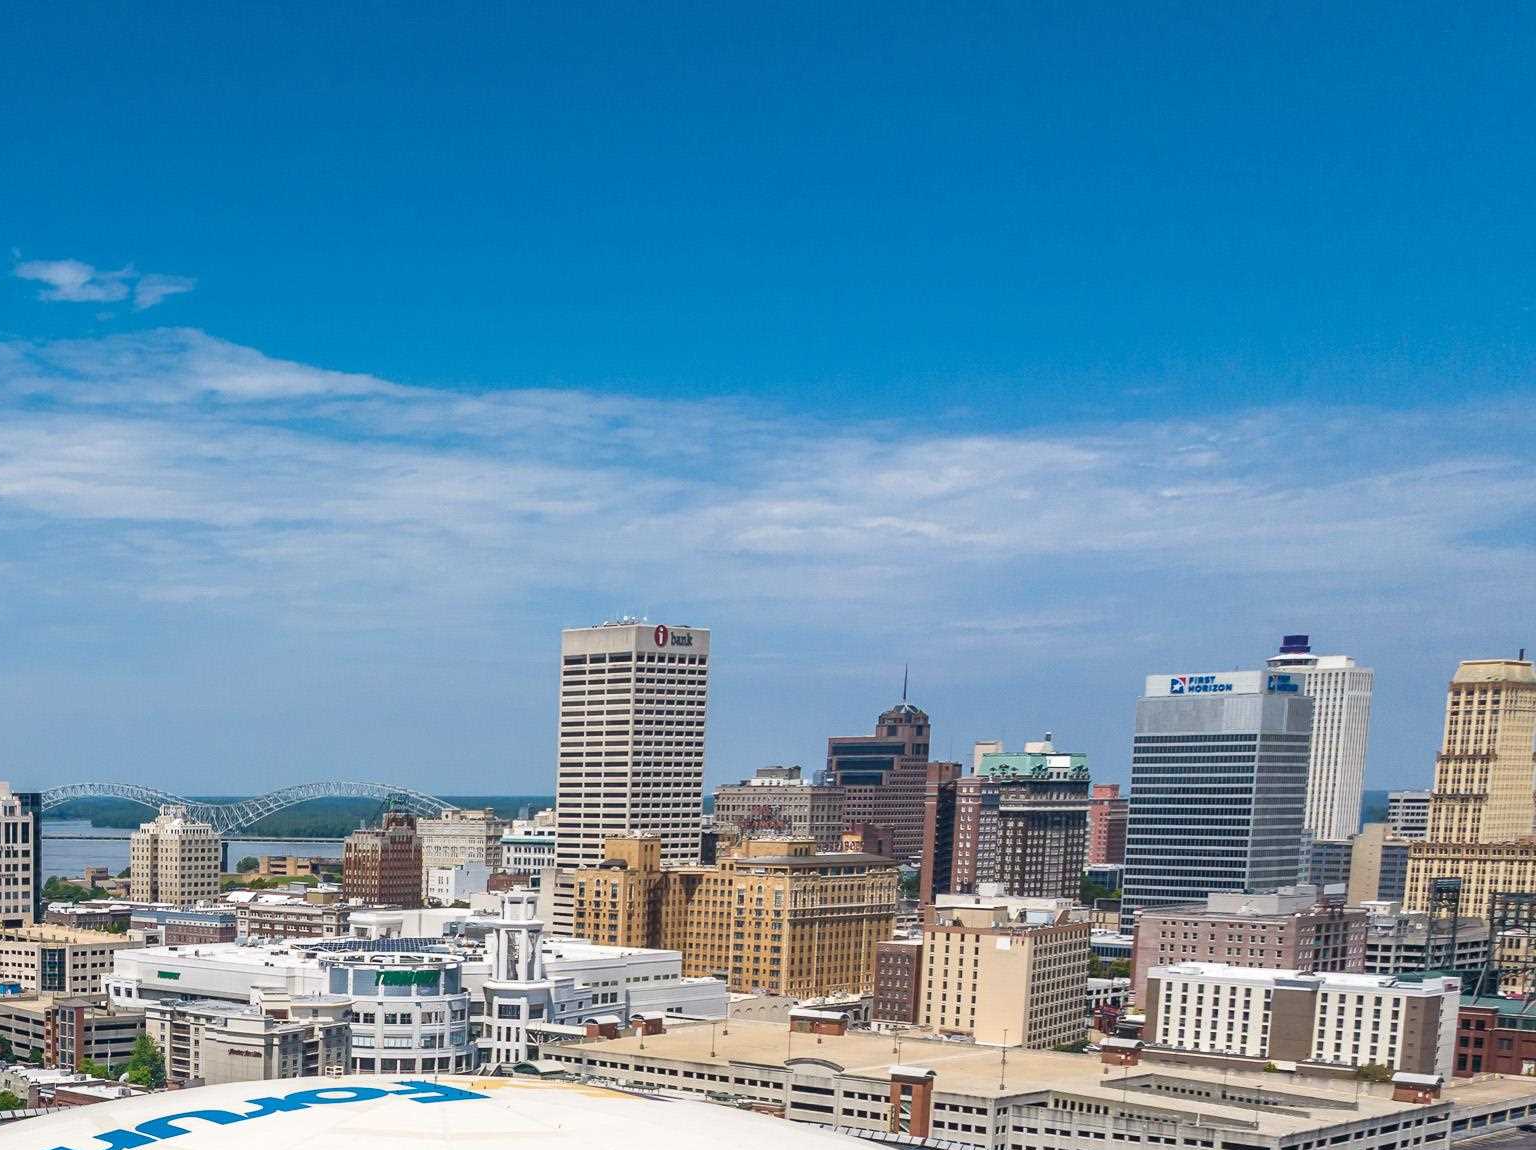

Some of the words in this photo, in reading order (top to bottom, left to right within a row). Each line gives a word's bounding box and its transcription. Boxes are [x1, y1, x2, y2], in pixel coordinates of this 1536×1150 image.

[671, 631, 693, 647] bank
[1188, 675, 1216, 685] FIRST
[1188, 683, 1233, 693] HORIZON
